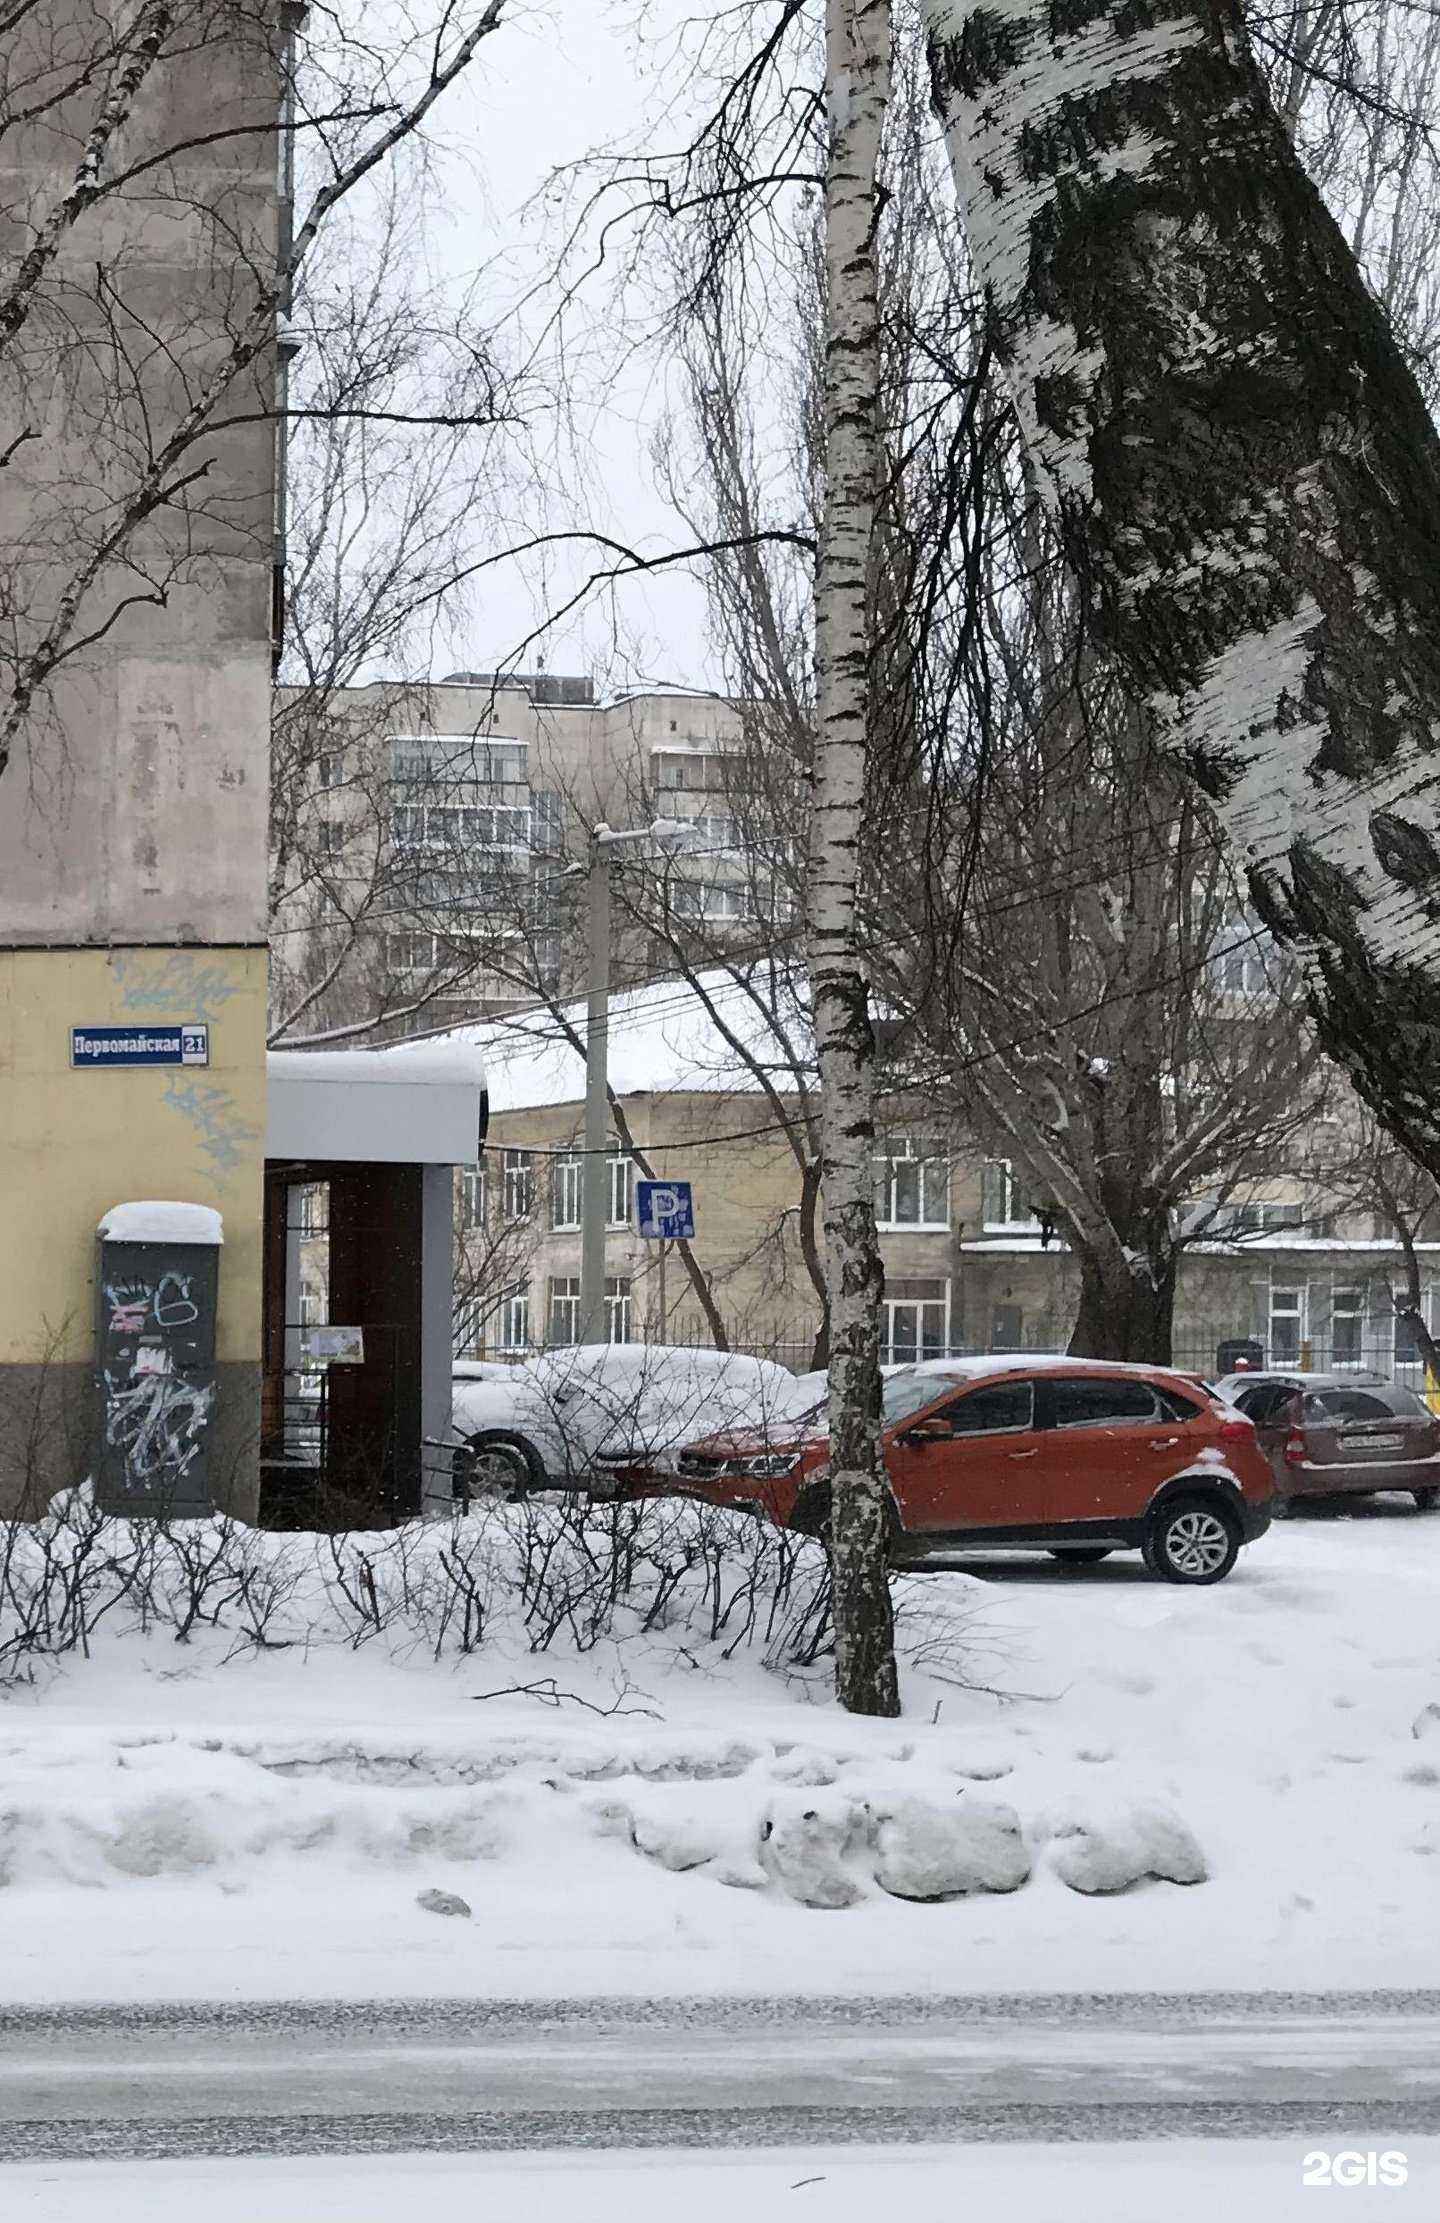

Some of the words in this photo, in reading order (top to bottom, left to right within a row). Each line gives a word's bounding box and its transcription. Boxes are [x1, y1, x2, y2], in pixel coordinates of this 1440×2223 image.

[74, 1034, 180, 1057] Первомайская
[184, 1037, 204, 1053] 21
[651, 1189, 680, 1233] P
